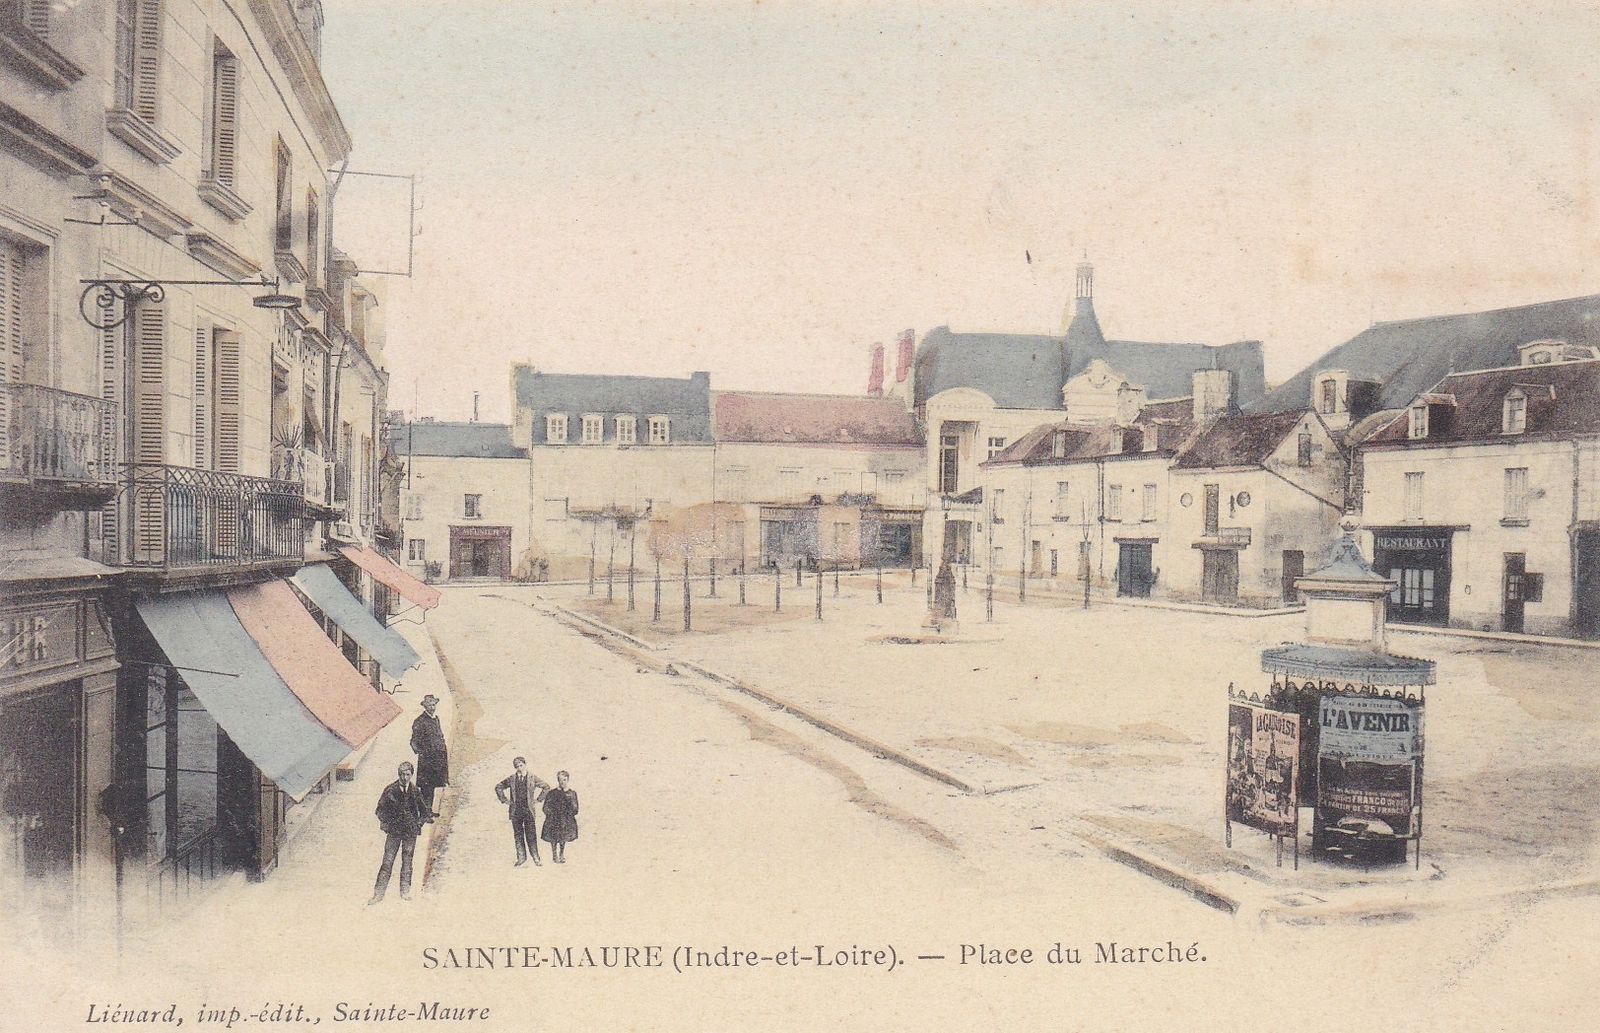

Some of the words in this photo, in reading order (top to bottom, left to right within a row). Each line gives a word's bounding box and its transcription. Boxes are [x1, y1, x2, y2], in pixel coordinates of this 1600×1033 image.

[1376, 537, 1447, 549] RESTAURANT
[1322, 708, 1410, 732] L'AVENIR
[1351, 795, 1386, 806] FRANCO
[1364, 805, 1376, 813] 25
